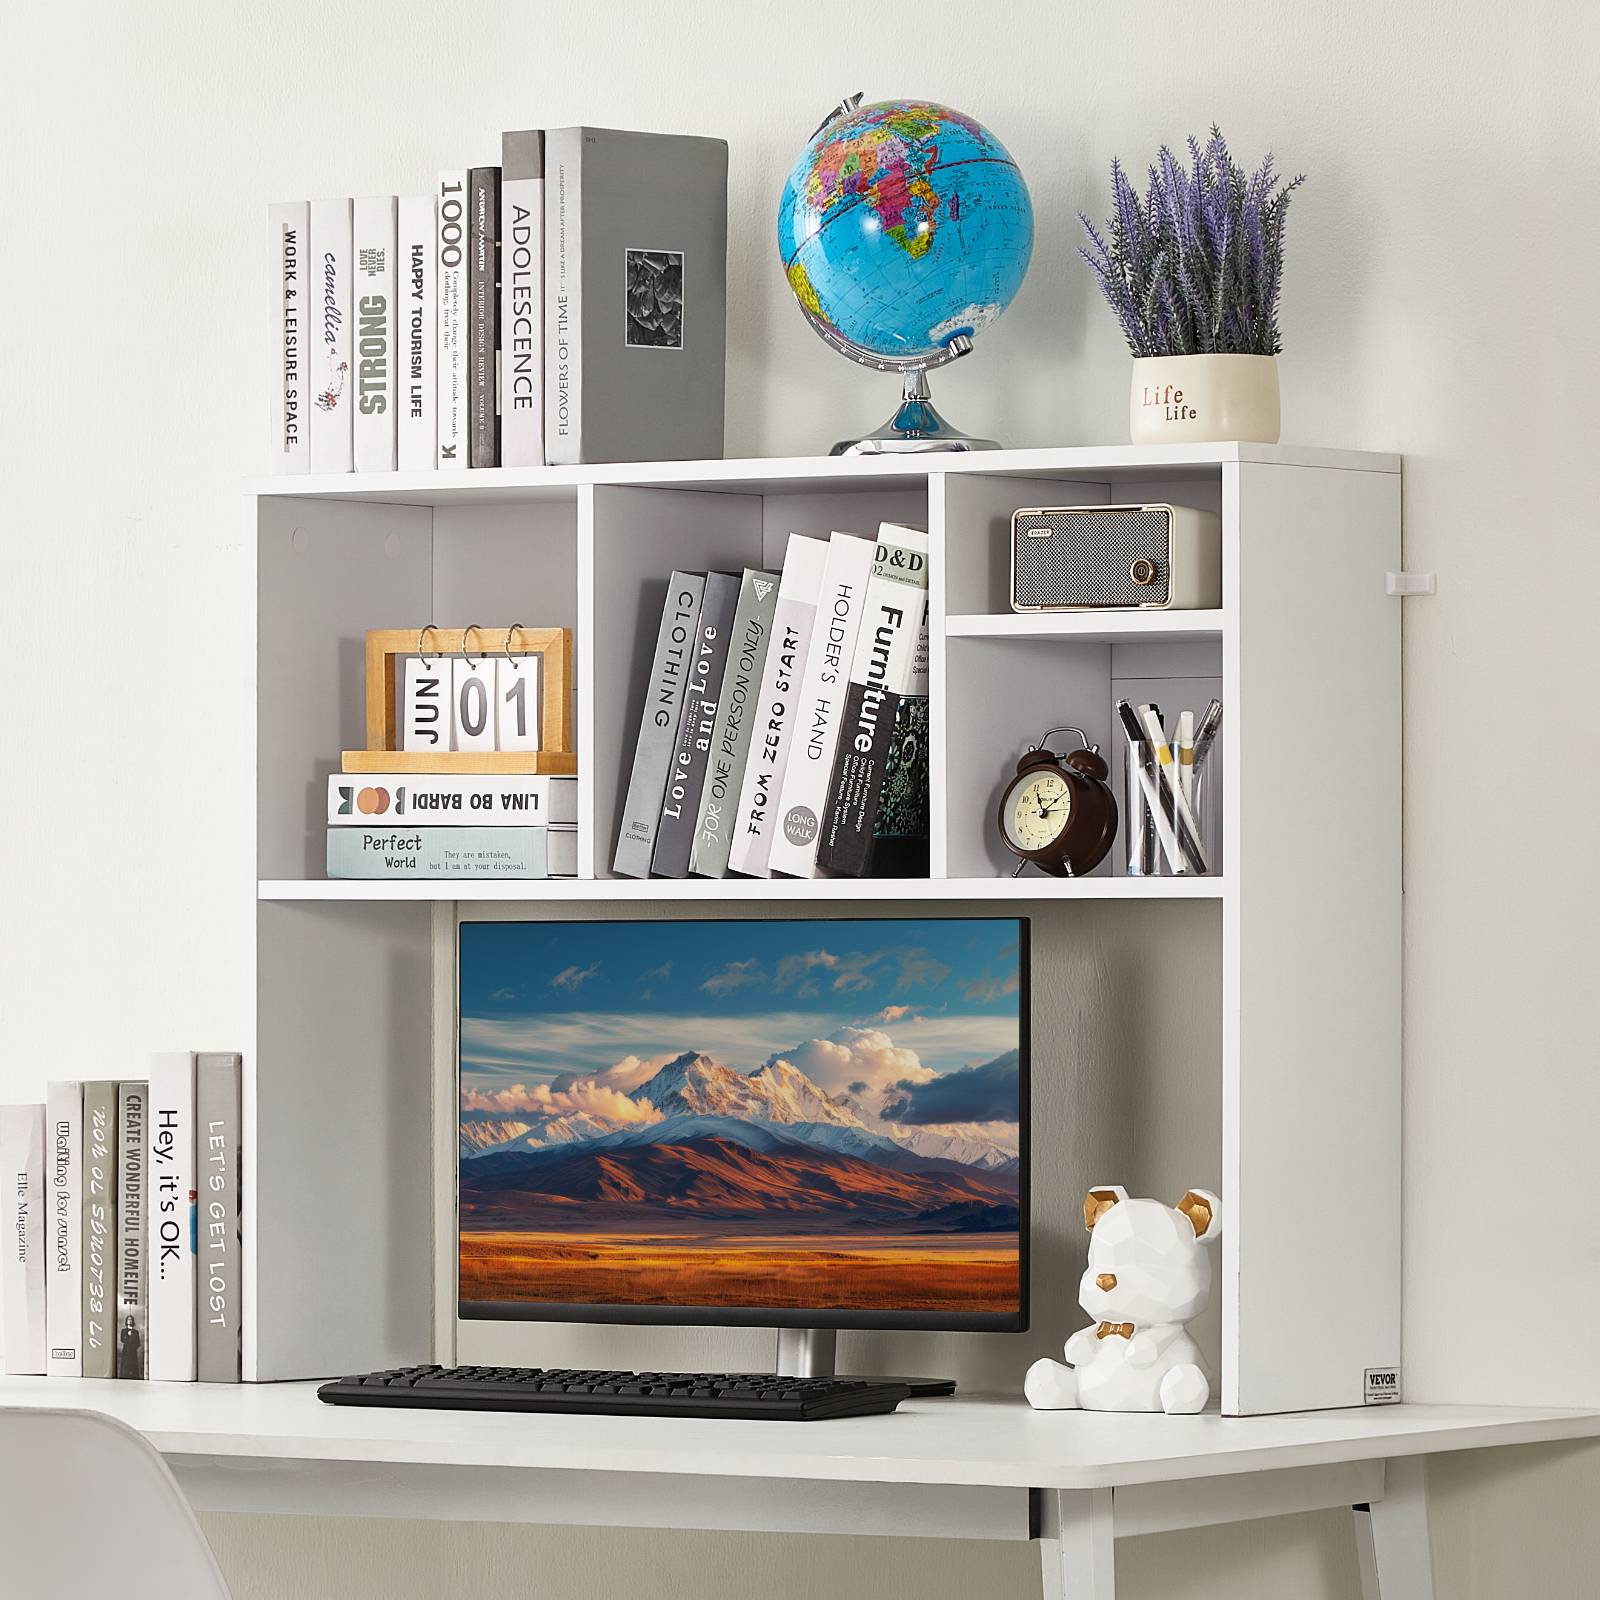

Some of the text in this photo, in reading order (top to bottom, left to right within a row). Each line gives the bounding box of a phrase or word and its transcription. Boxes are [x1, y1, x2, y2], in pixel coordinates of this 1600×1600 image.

[441, 181, 462, 268] 1000
[360, 248, 368, 270] LOVE
[368, 248, 376, 276] NEVER
[376, 248, 385, 272] DIES.
[324, 252, 342, 346] camellia
[512, 204, 532, 410] ADOLESCENCE
[285, 230, 298, 444] WORK & LEISURE SPACE
[359, 295, 386, 415] STRONG
[411, 244, 424, 418] HAPPY TOURISM LIFE
[558, 296, 568, 436] FLOWERS OF TIME
[1144, 384, 1183, 406] Life
[1166, 406, 1196, 420] Life
[442, 444, 456, 458] K
[654, 591, 694, 728] CLOTHING
[808, 584, 852, 760] HOLDER'S HAND
[854, 605, 904, 752] Furniture
[414, 678, 440, 744] JUN
[664, 626, 717, 821] Love and Love
[721, 674, 750, 757] PERSON
[747, 626, 799, 835] FROM ZERO START
[712, 760, 732, 799] ONE
[841, 756, 859, 825] Office Furniture System
[843, 754, 851, 776] Special
[853, 778, 863, 806] Furniture
[1046, 780, 1054, 788] 12
[412, 793, 539, 810] LINA BO BARDI
[788, 812, 815, 827] LONG
[856, 759, 875, 832] Current Furniture Design
[1022, 796, 1030, 804] 10
[363, 834, 422, 850] Perfect
[384, 856, 416, 868] World
[444, 850, 459, 859] They
[478, 851, 510, 859] mistaken,
[786, 825, 814, 840] WALK.
[494, 862, 526, 871] disposal.
[153, 1110, 178, 1164] Hey,
[16, 1172, 29, 1263] Elle Magazine
[54, 1122, 70, 1272] Waiting for sunset
[123, 1094, 142, 1305] CREATE WONDERFUL HOMELIFE
[159, 1176, 181, 1212] it's
[89, 1106, 108, 1348] IT BELONGS TO YOU.
[208, 1121, 226, 1328] LET'S GET LOST
[1370, 1373, 1396, 1386] VEVOR
